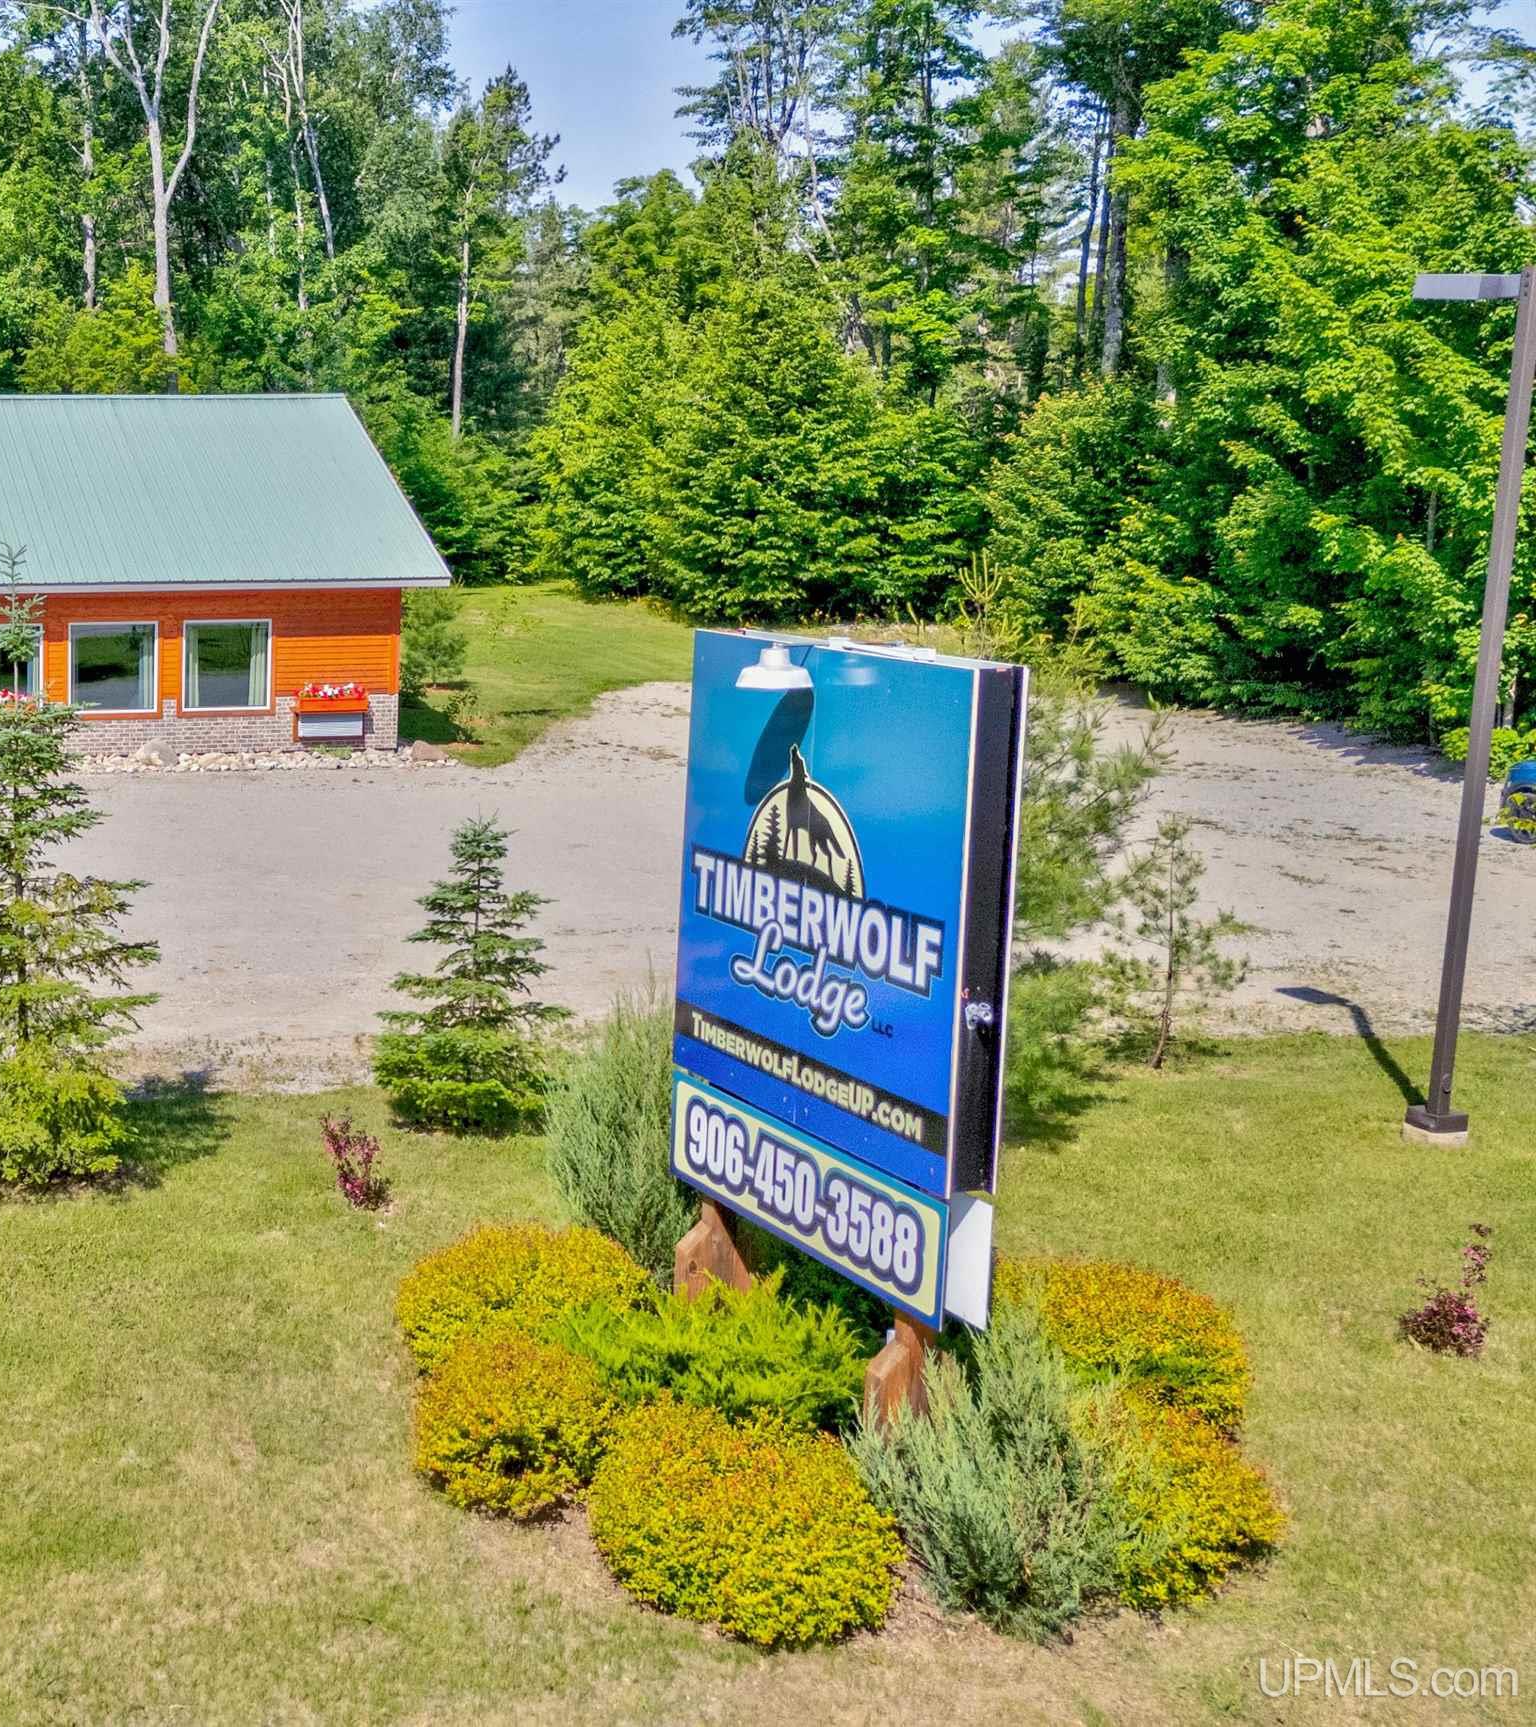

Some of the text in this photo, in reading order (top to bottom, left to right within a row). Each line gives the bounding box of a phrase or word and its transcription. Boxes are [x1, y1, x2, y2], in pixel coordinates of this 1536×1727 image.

[694, 852, 942, 989] TIMBERWOLF
[734, 921, 894, 1039] Lodge LLC
[689, 1105, 918, 1284] 906-450-3588
